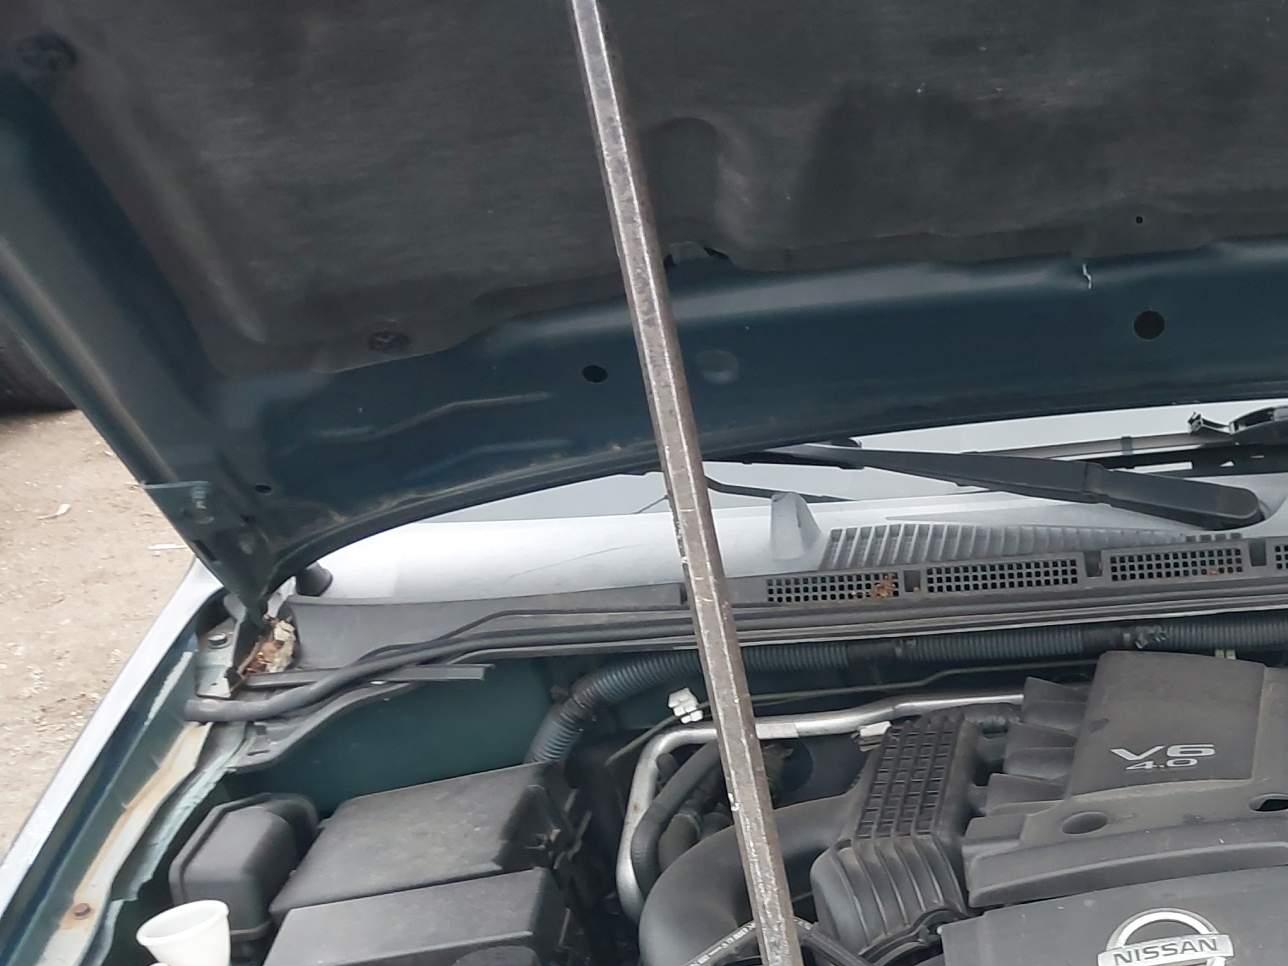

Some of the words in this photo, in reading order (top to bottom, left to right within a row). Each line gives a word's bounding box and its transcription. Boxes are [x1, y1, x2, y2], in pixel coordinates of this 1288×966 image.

[1110, 744, 1216, 761] V6
[1125, 758, 1198, 770] 4.0
[1112, 938, 1218, 966] NISSAN
